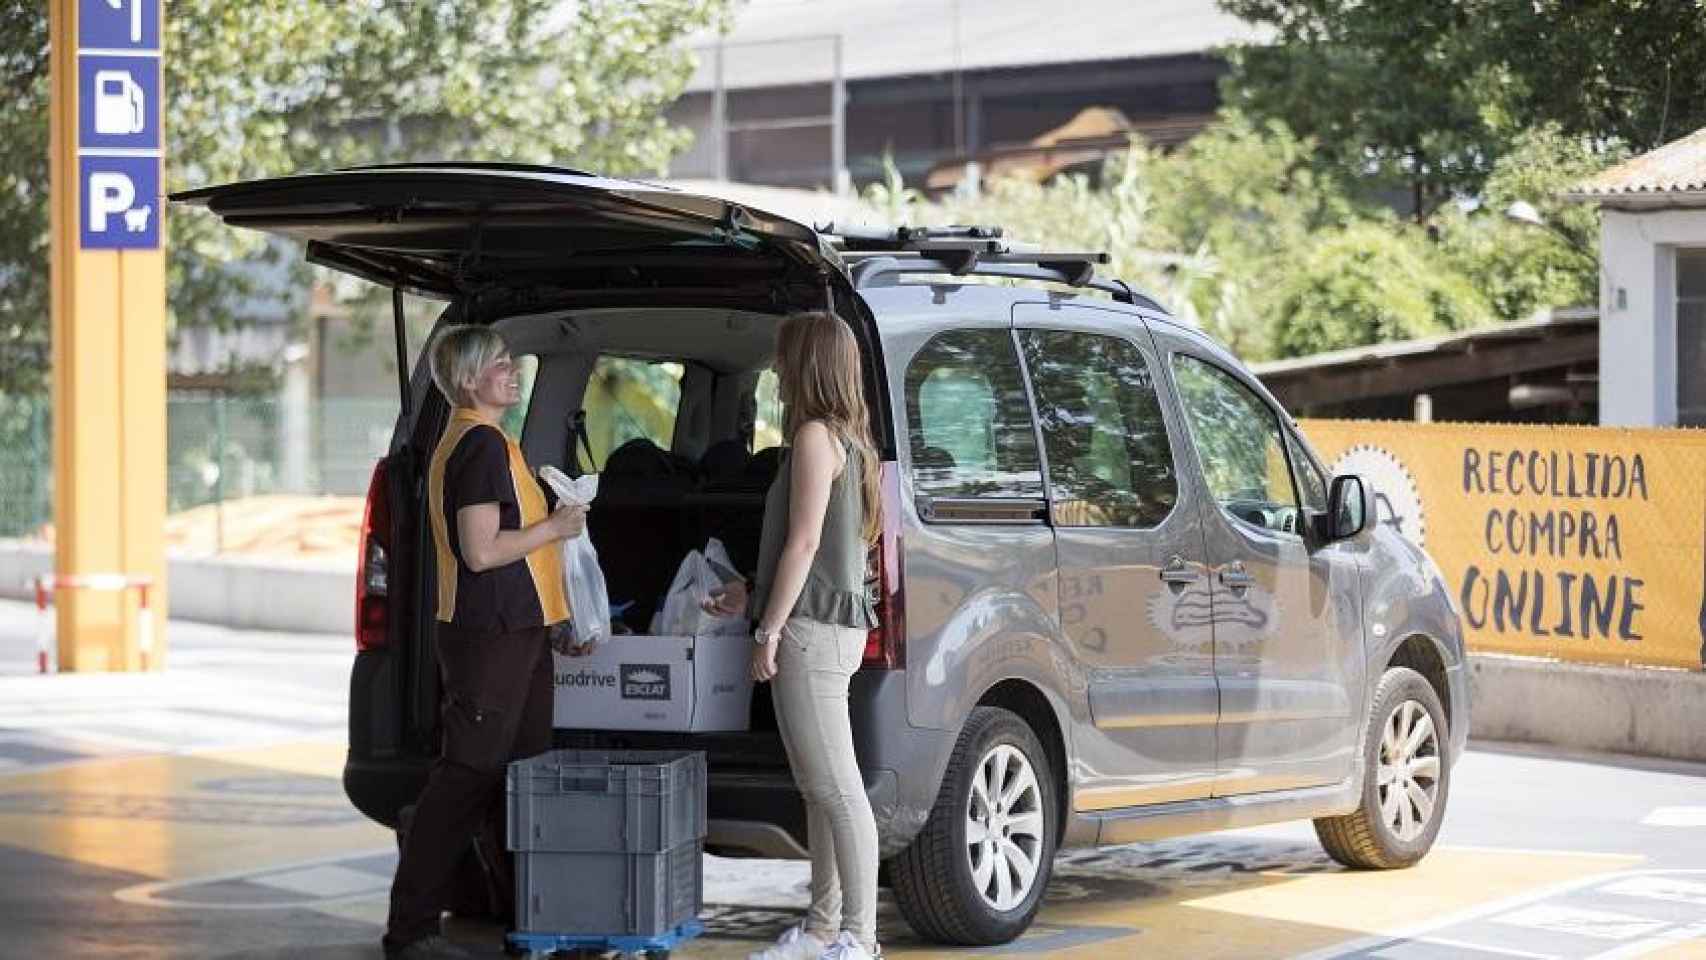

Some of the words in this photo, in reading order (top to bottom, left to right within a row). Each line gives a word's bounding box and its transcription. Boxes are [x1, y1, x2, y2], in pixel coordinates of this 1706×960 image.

[89, 172, 136, 232] P
[1463, 447, 1649, 500] RECOLLIDA
[1485, 508, 1622, 560] COMPRA
[1461, 565, 1646, 641] ONLINE
[555, 669, 616, 689] uodrive
